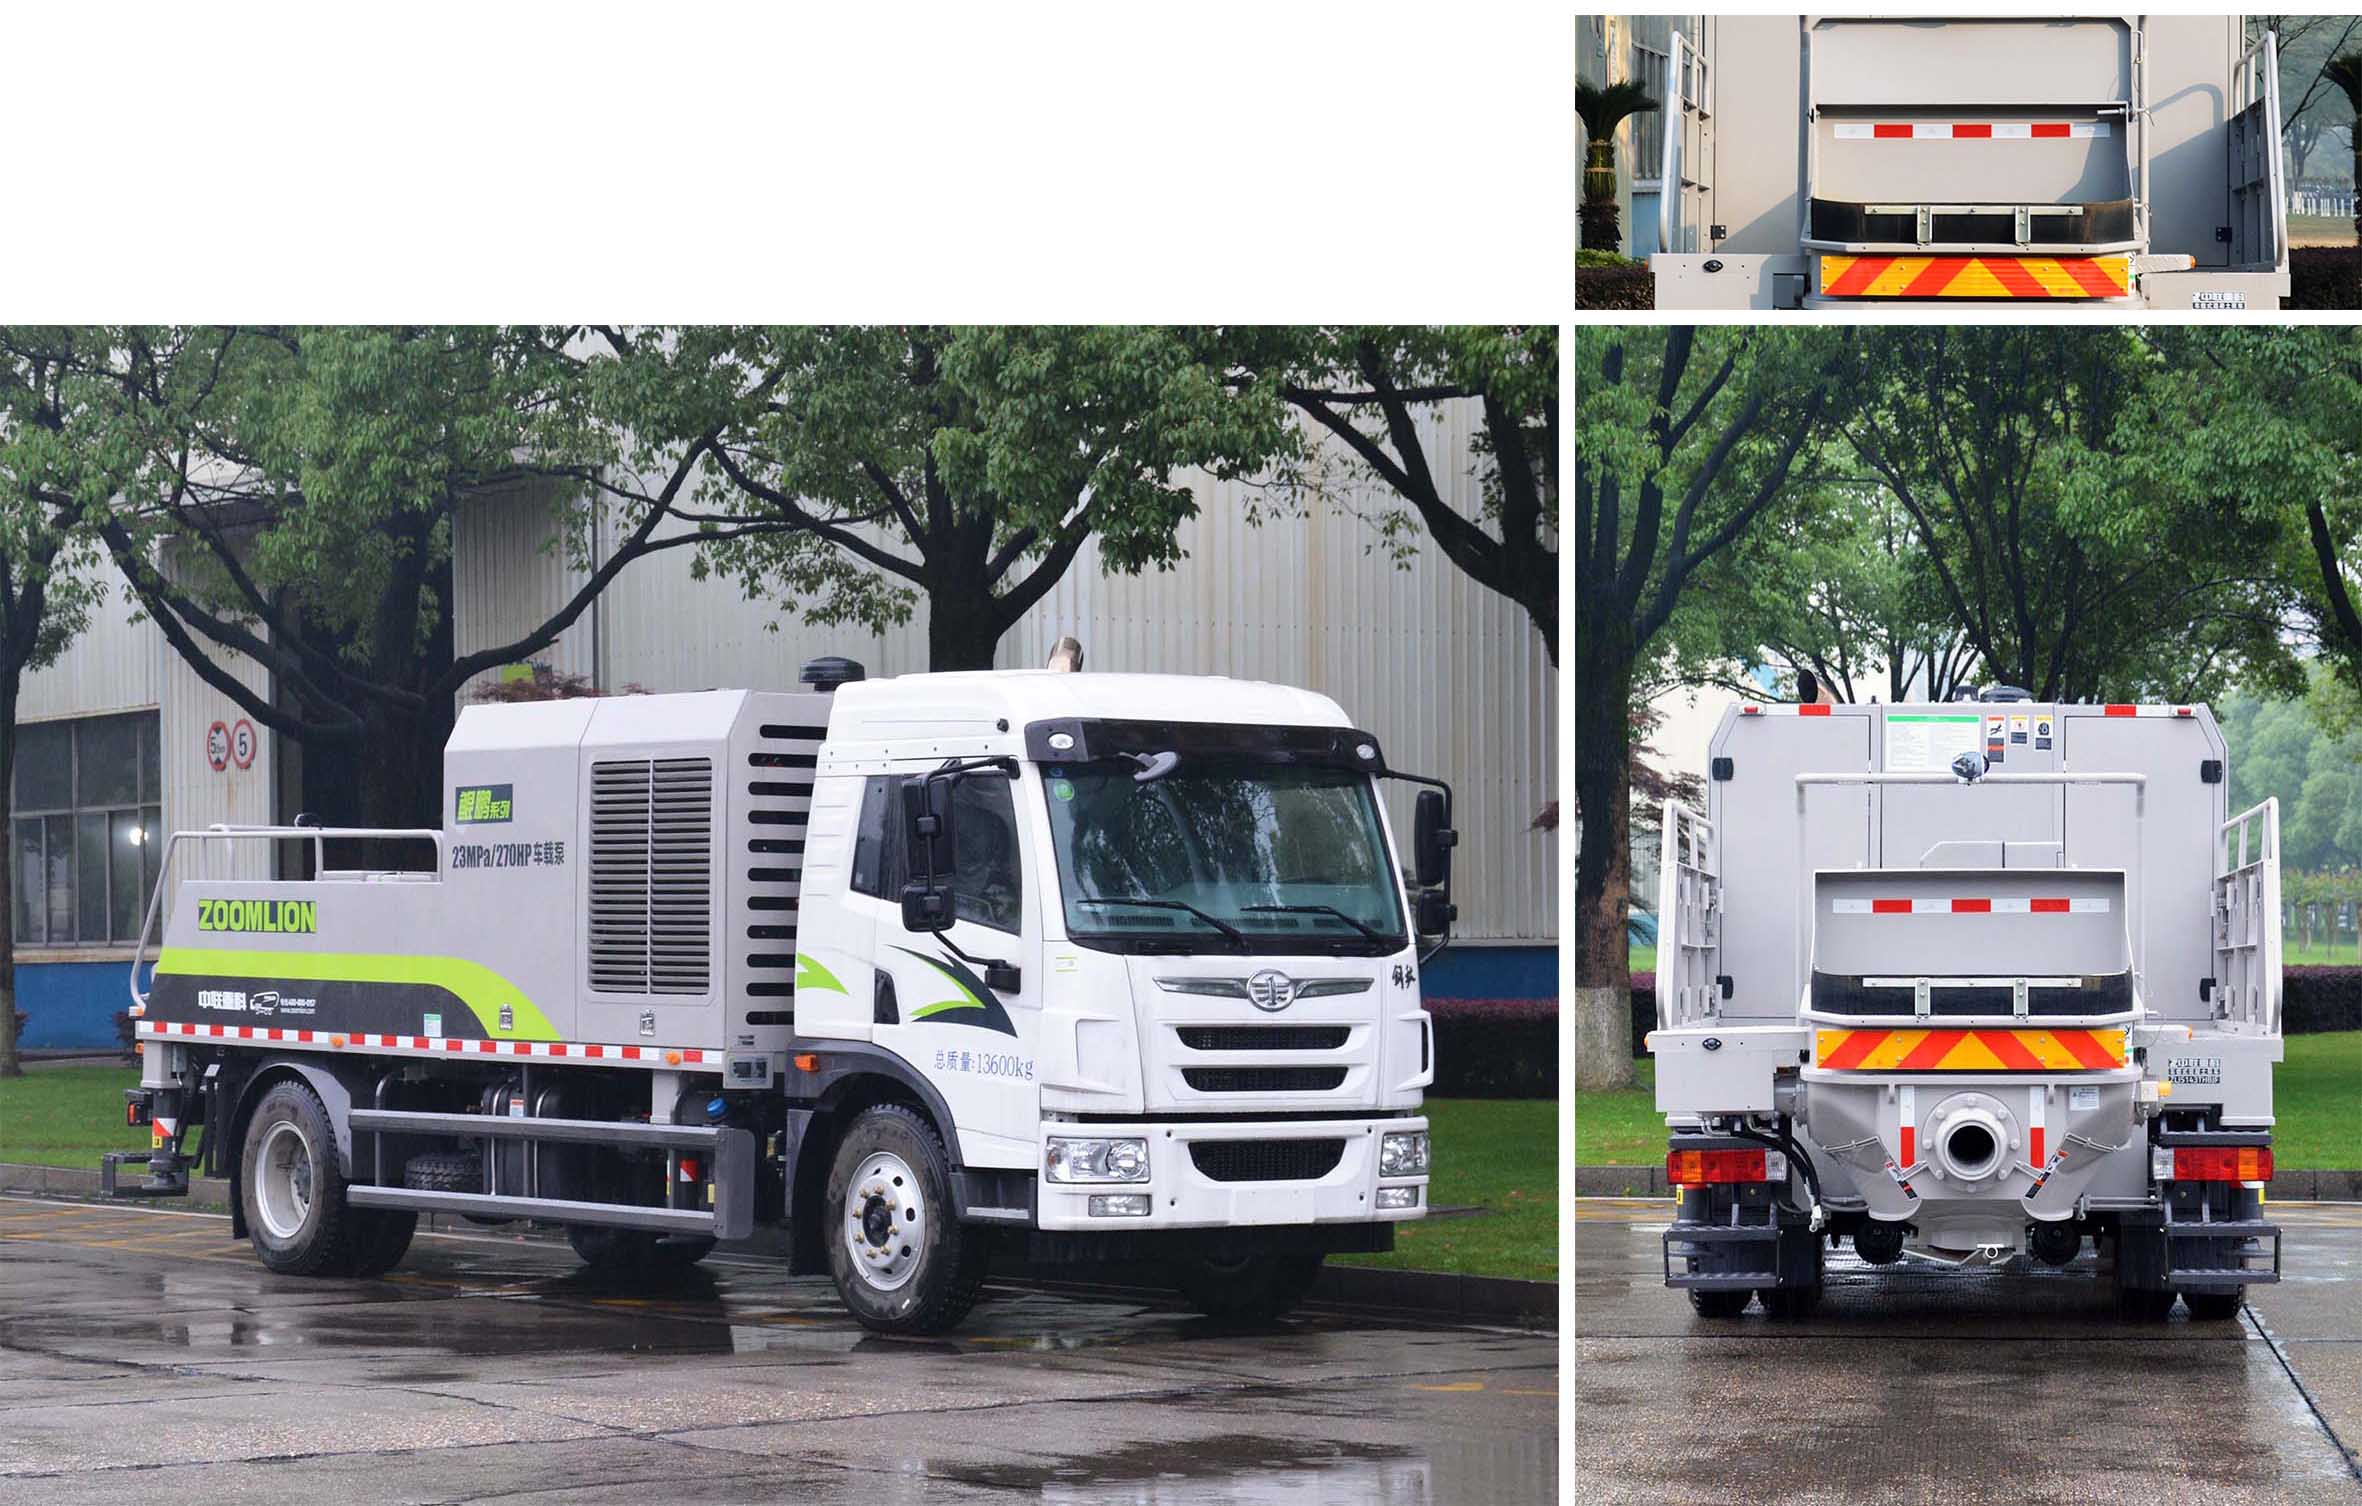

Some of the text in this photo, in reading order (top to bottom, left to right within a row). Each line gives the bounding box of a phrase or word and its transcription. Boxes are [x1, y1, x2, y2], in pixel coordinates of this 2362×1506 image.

[239, 733, 247, 757] 5
[452, 841, 565, 869] 23MPa/270HP 车载泵
[199, 900, 317, 933] ZOOMLION
